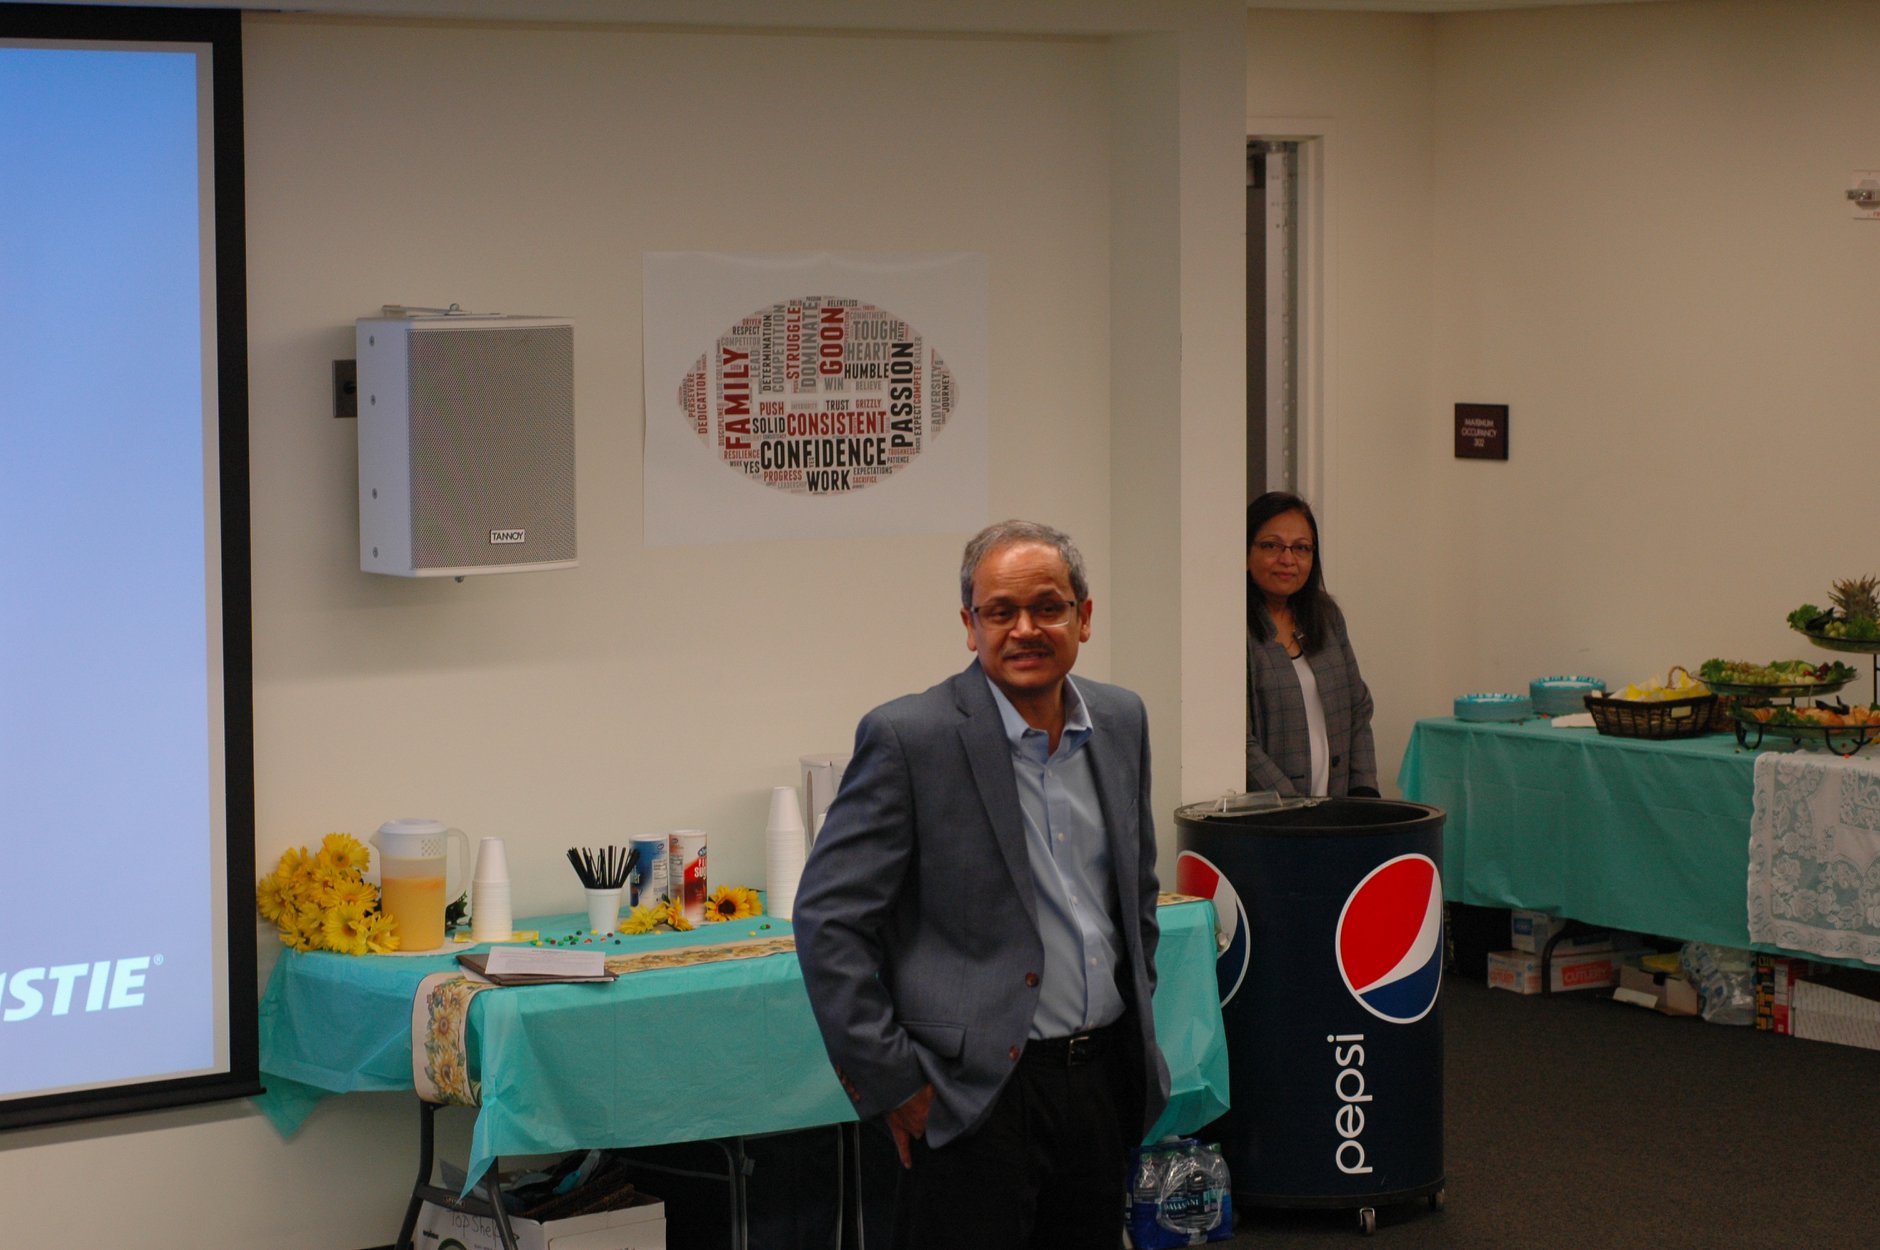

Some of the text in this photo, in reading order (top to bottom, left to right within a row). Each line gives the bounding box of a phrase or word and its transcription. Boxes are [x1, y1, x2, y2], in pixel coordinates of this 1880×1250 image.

[850, 311, 887, 320] COMMITMENT
[732, 326, 760, 335] RESPECT
[853, 321, 898, 340] TOUGH
[721, 337, 761, 346] COMPETITOR
[772, 304, 785, 393] COMPETITION
[786, 306, 801, 380] STRUGGLE
[801, 302, 818, 388] DOMINATE
[819, 308, 844, 375] GOON
[763, 314, 772, 391] DETERMINATION
[847, 342, 888, 361] HEART
[750, 350, 760, 378] LEAD
[844, 363, 889, 379] HUMBLE
[824, 377, 844, 391] WIN
[855, 380, 882, 391] BELIEVE
[913, 364, 922, 404] COMPETE
[942, 374, 950, 413] JOURNEY
[687, 372, 696, 418] PERSEVERE
[696, 372, 708, 434] DEDICATION
[722, 347, 752, 449] FAMILY
[855, 399, 882, 409] GRIZZLY
[890, 342, 914, 447] PASSION
[931, 364, 942, 425] ADVERSITY
[760, 402, 785, 415] PUSH
[826, 400, 849, 411] TRUST
[716, 407, 725, 446] DISCIPLINE
[752, 417, 785, 434] SOLID
[787, 410, 887, 437] CONSISTENT
[913, 405, 922, 435] EXPECT
[1461, 427, 1497, 437] OCCUPANCY
[723, 449, 760, 459] RESILIENCE
[760, 437, 887, 470] CONFIDENCE
[887, 456, 909, 464] PATIENCE
[888, 448, 916, 456] TOUGHNESS
[743, 460, 760, 474] YES
[763, 470, 803, 482] PROGRESS
[853, 466, 893, 475] EXPECTATIONS
[806, 469, 851, 492] WORK
[852, 475, 877, 484] SACRIFICE
[492, 531, 523, 540] TANNOY
[1565, 967, 1608, 983] CUTLERY
[0, 956, 150, 1022] STIE
[1327, 1033, 1373, 1174] pepsi
[451, 1212, 470, 1238] Top
